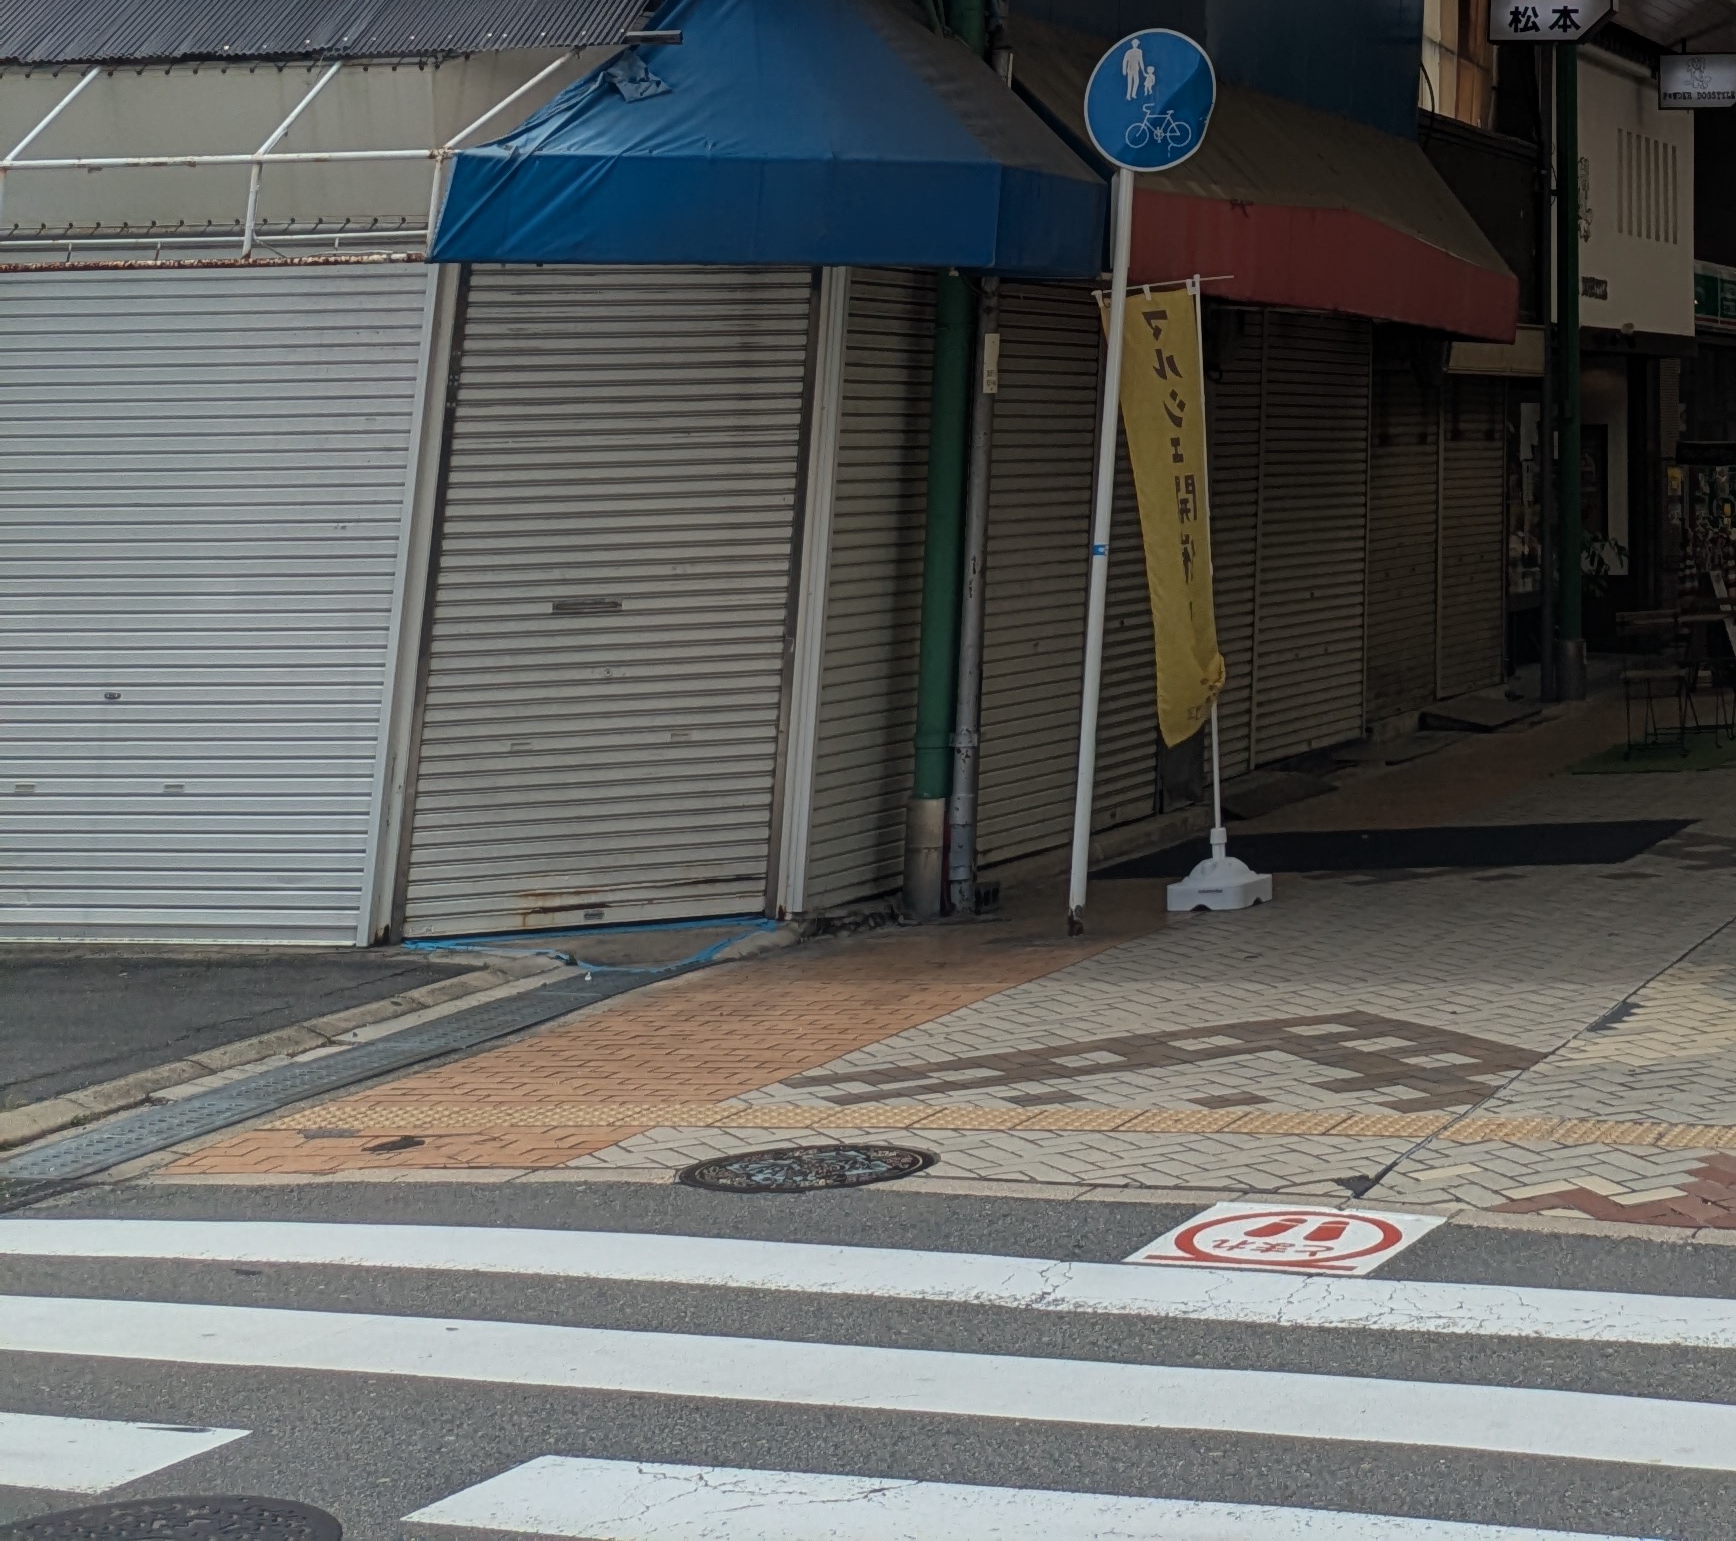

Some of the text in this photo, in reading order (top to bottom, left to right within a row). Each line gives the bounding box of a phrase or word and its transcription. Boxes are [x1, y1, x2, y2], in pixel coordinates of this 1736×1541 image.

[1507, 4, 1582, 34] 松本
[1212, 1237, 1335, 1260] とまれ
